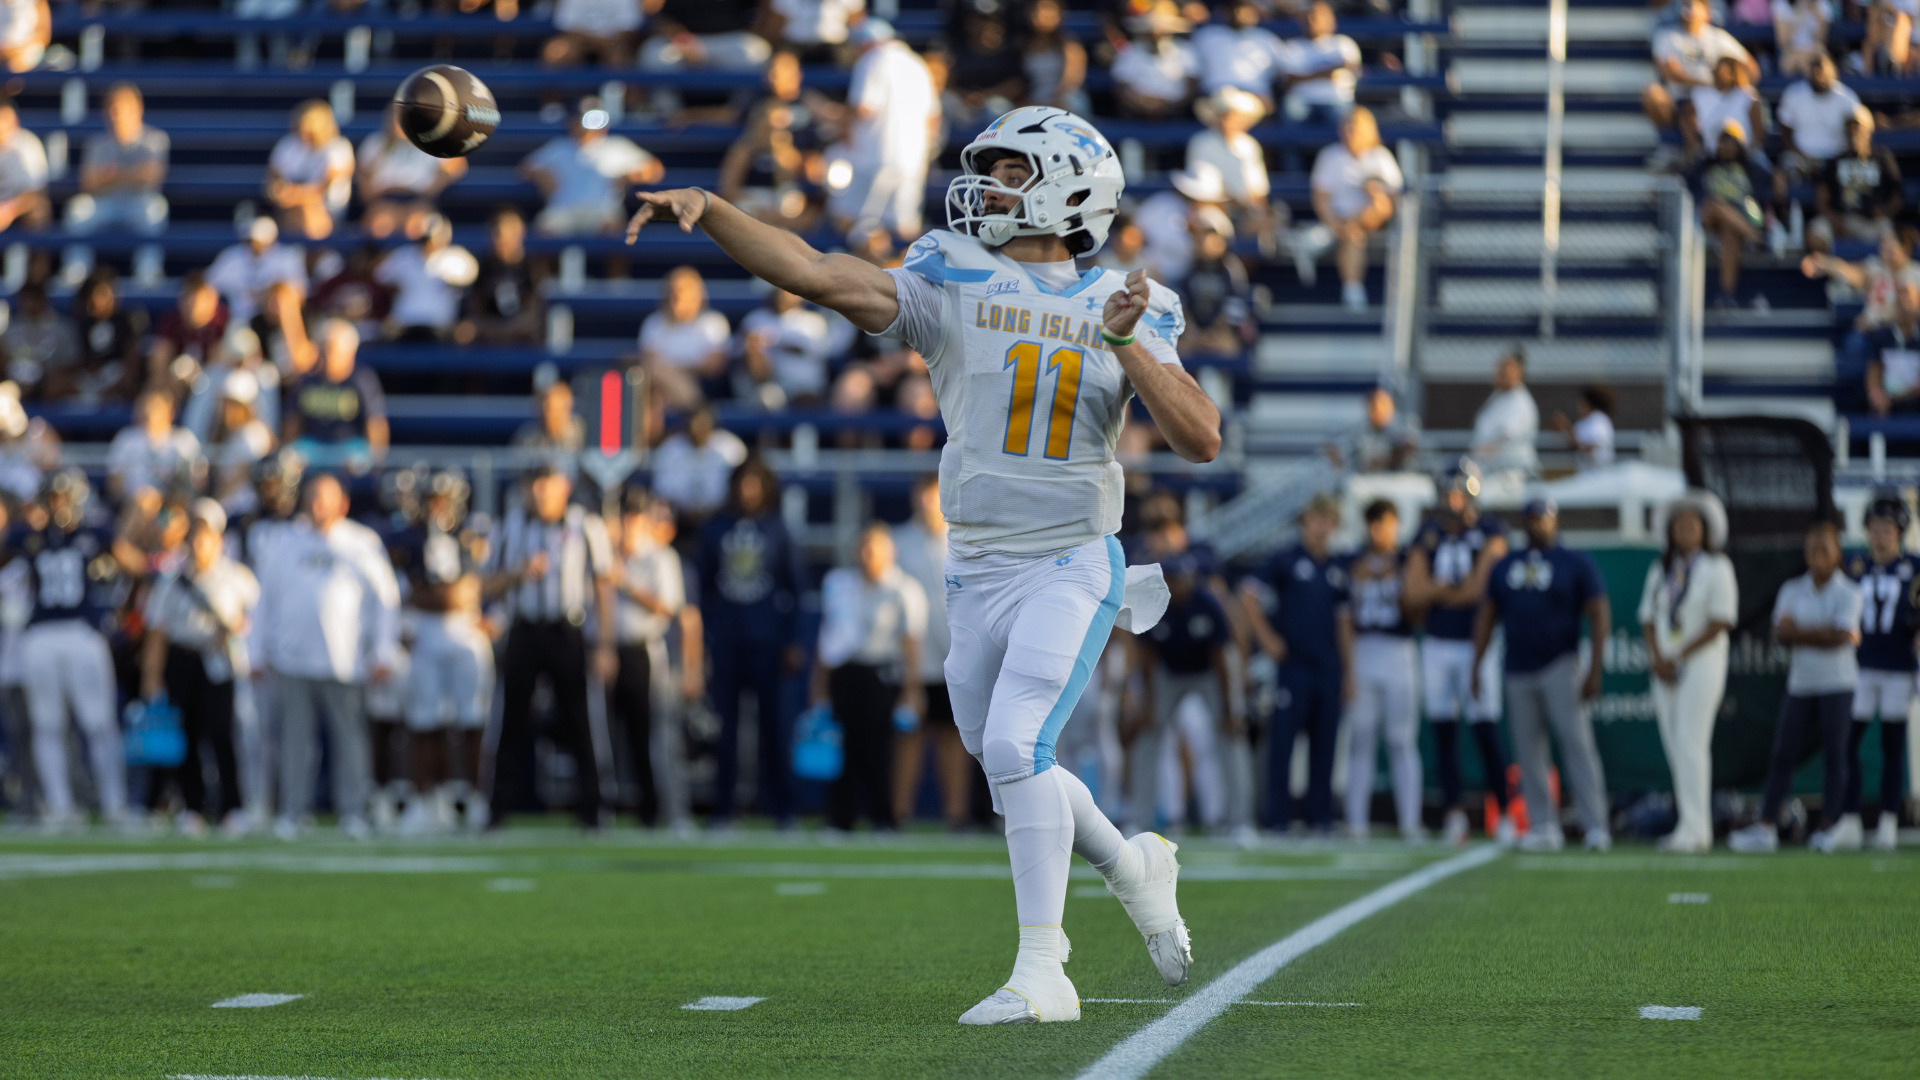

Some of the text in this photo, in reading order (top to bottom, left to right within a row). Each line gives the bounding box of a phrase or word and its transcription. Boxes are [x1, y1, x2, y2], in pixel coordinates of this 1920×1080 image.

[987, 279, 1020, 296] NEC
[976, 301, 1032, 334] LONG
[1002, 339, 1085, 461] 11
[1861, 574, 1901, 634] 17
